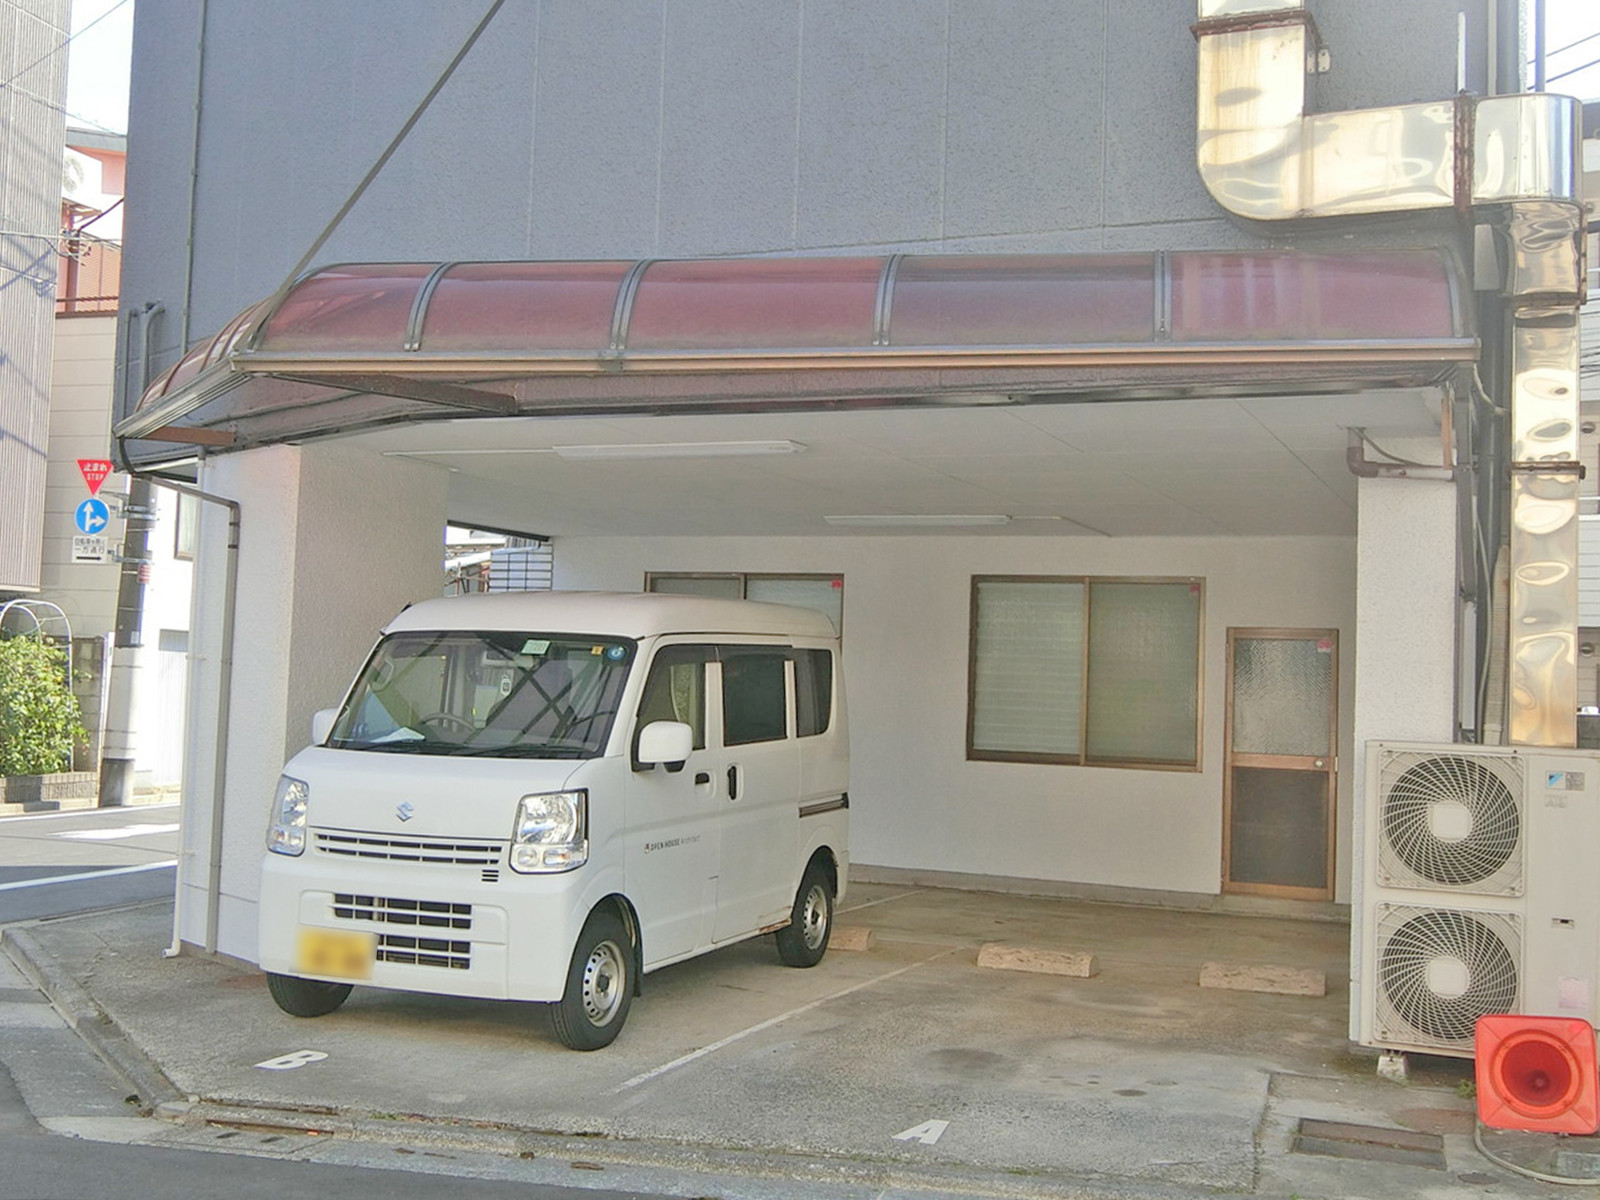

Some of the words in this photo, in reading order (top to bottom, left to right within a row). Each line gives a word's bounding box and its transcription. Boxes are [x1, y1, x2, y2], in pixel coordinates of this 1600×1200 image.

[83, 463, 107, 472] 止まれ
[86, 473, 104, 481] STOP
[75, 546, 105, 555] 一方通行
[650, 842, 664, 851] OPEN
[664, 838, 680, 847] HOUSE
[253, 1049, 329, 1070] B
[891, 1119, 950, 1145] A
